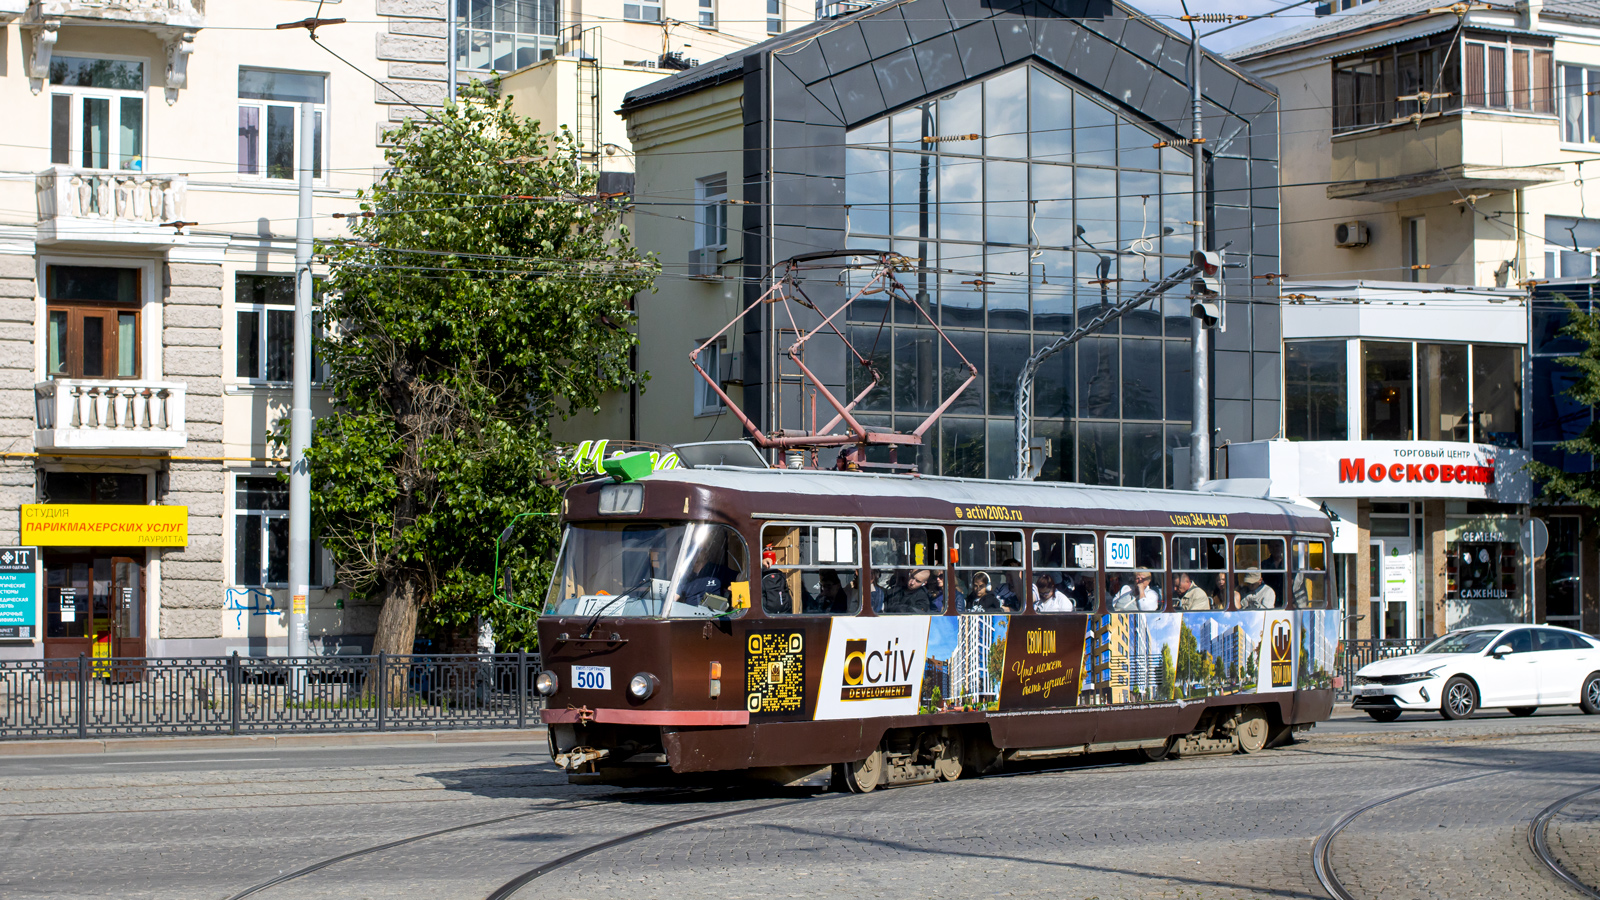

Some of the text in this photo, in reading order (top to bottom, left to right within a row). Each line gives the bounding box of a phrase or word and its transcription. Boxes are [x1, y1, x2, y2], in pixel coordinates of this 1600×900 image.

[1394, 448, 1471, 459] ТОРГОВЫЙ ЦЕНТР
[611, 488, 634, 512] 17
[25, 508, 69, 518] СТУДИЯ
[965, 505, 1023, 521] activ2003.ru
[25, 522, 184, 533] ПАРИКМАХЕРСКИХ УСЛУГ
[138, 535, 184, 543] ЛАУРИТТА
[1462, 531, 1504, 542] СЕМЕНА
[1111, 542, 1130, 560] 500
[1460, 588, 1508, 599] САЖЕНЦЫ
[582, 598, 598, 616] 17
[1027, 627, 1056, 657] СВОЙ ДОМ
[842, 637, 916, 685] activ
[577, 671, 604, 688] 500
[1011, 659, 1063, 684] Что может
[1272, 663, 1292, 686] СВОЙ ДОМ
[848, 685, 906, 699] DEVELOPMENT
[1022, 677, 1042, 696] быть
